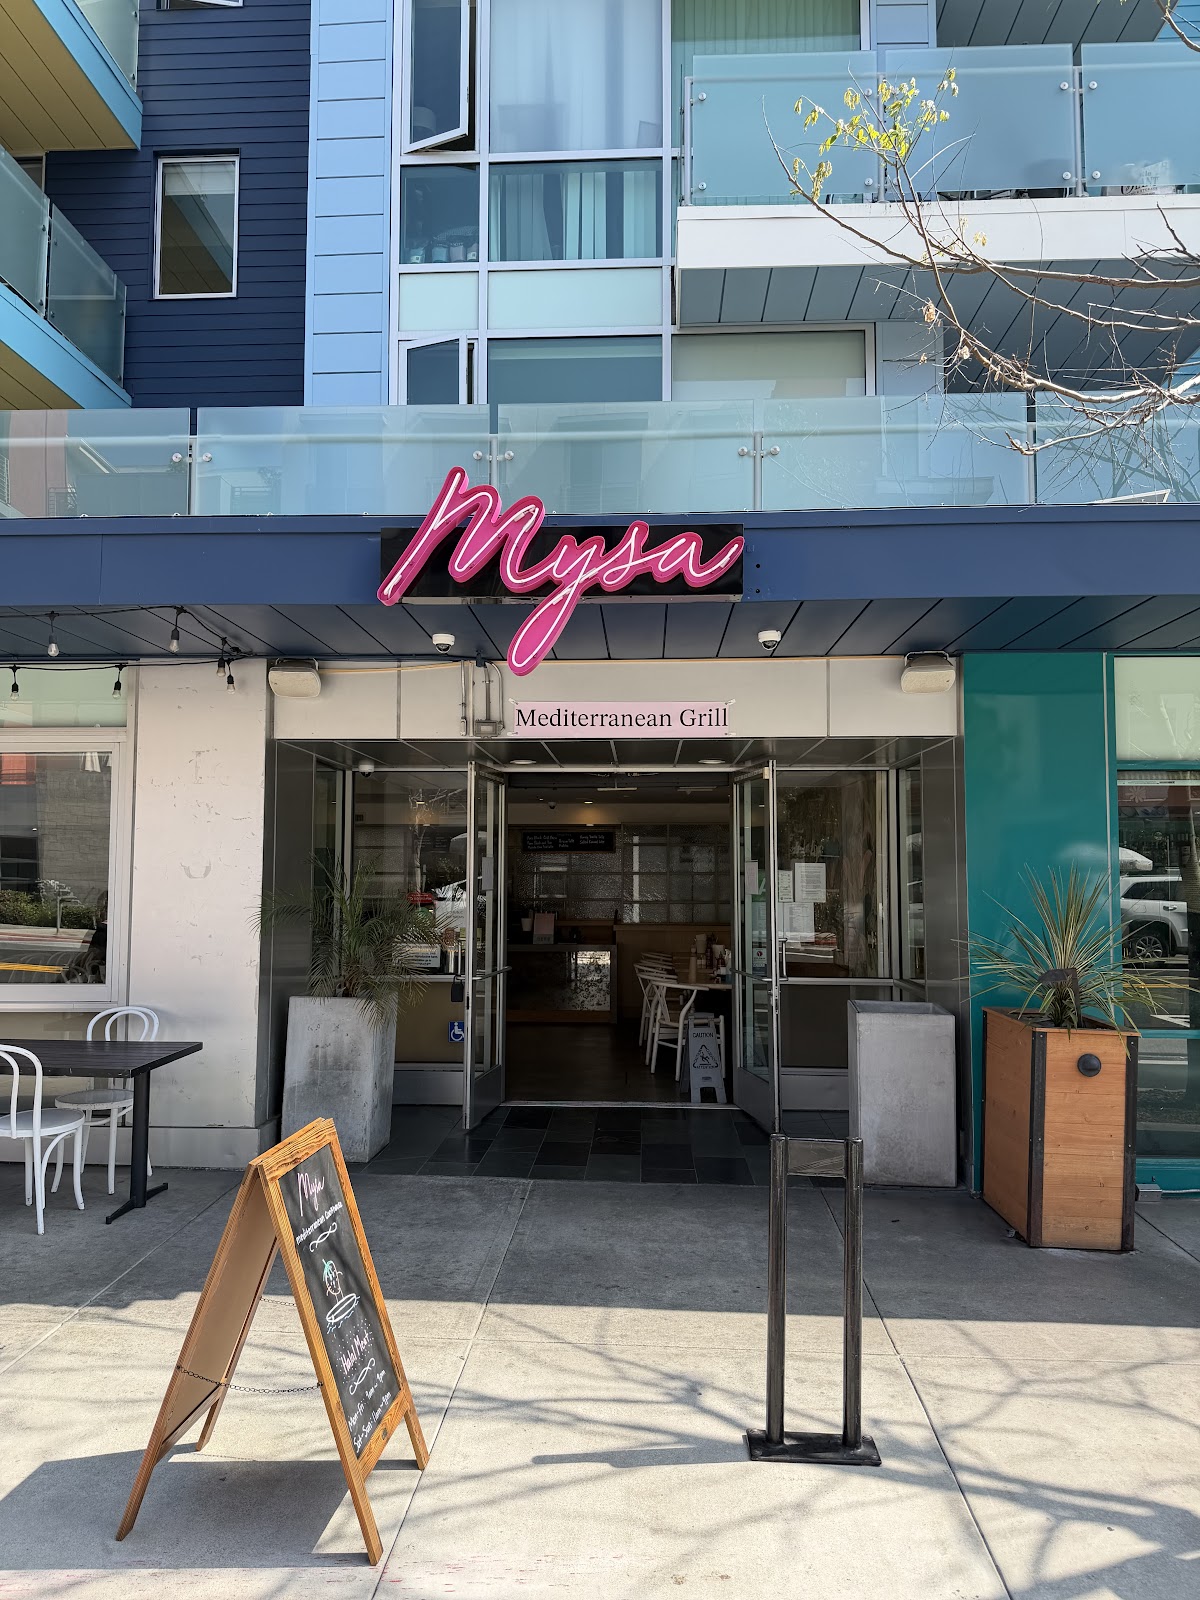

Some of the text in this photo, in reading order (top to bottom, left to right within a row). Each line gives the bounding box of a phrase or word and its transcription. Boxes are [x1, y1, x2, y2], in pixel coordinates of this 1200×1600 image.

[377, 465, 745, 677] Mysa
[515, 707, 729, 728] Mediterranean Grill
[340, 1328, 370, 1375] Halal Meat
